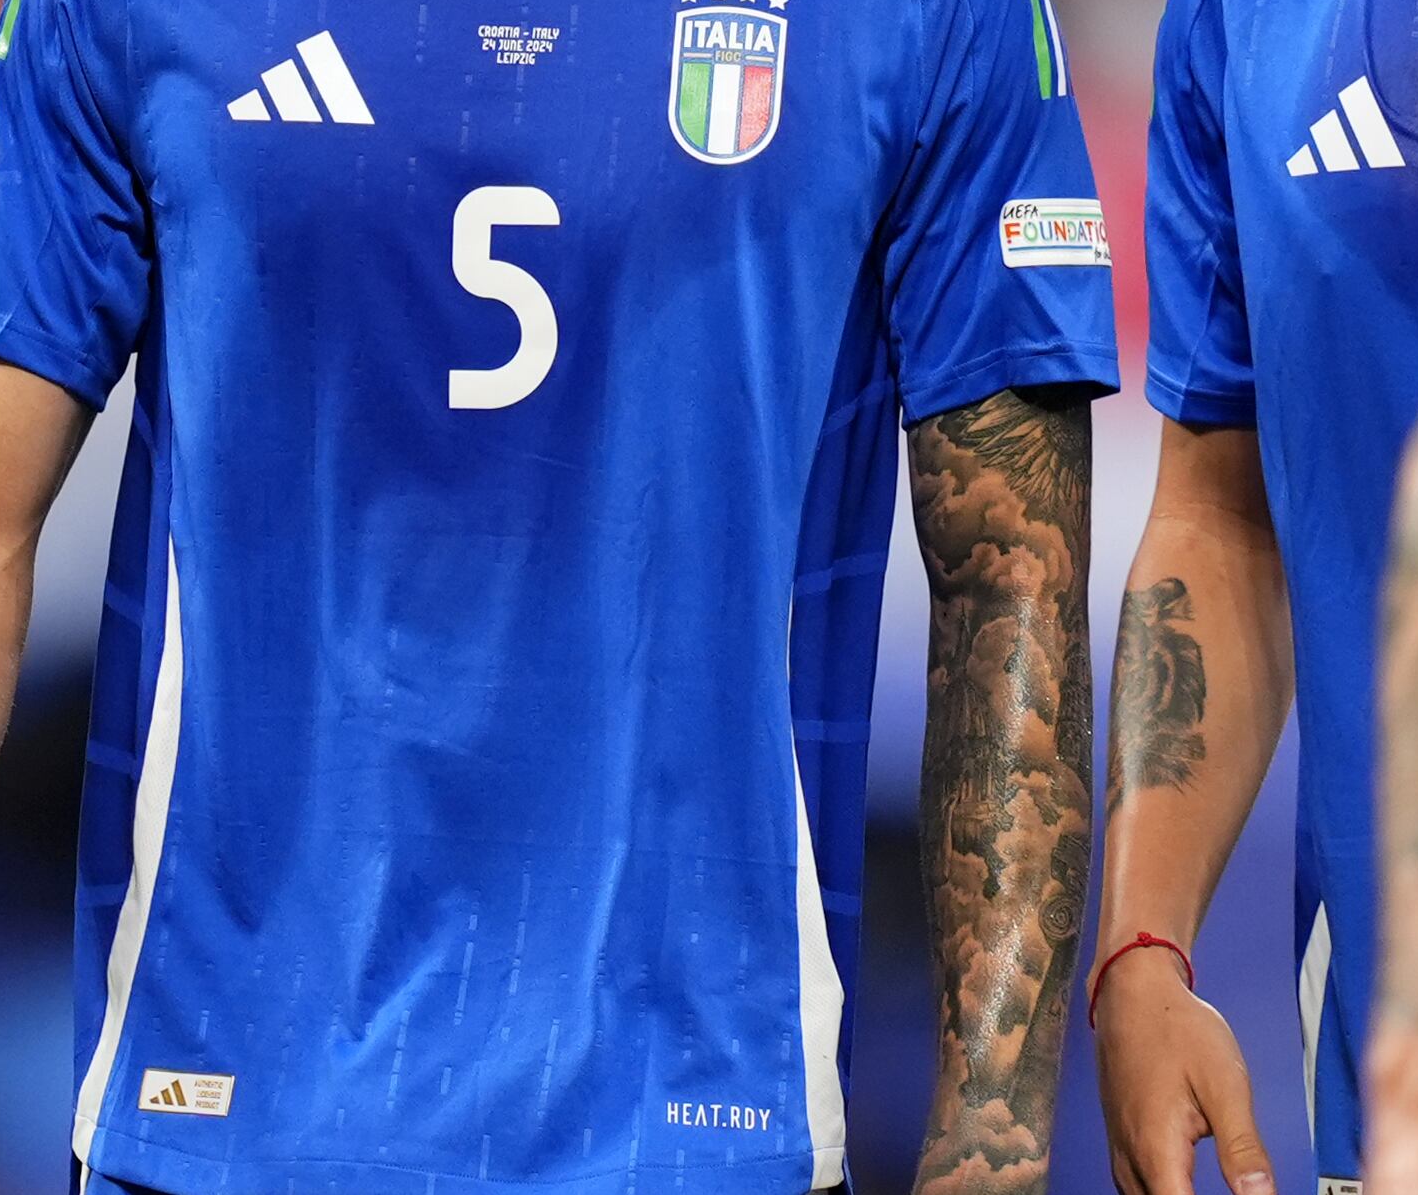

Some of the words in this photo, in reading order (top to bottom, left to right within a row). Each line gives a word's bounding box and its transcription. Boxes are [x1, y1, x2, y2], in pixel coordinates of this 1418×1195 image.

[477, 25, 521, 38] CROATIA
[532, 27, 560, 40] ITALY
[683, 20, 775, 53] ITALIA
[482, 38, 496, 51] 24
[498, 39, 524, 52] JUNE
[526, 40, 553, 53] 2024
[496, 52, 536, 65] LEIPZIG
[1003, 204, 1039, 220] UEFA
[449, 186, 561, 410] 5
[667, 1102, 771, 1131] HEAT.RDY
